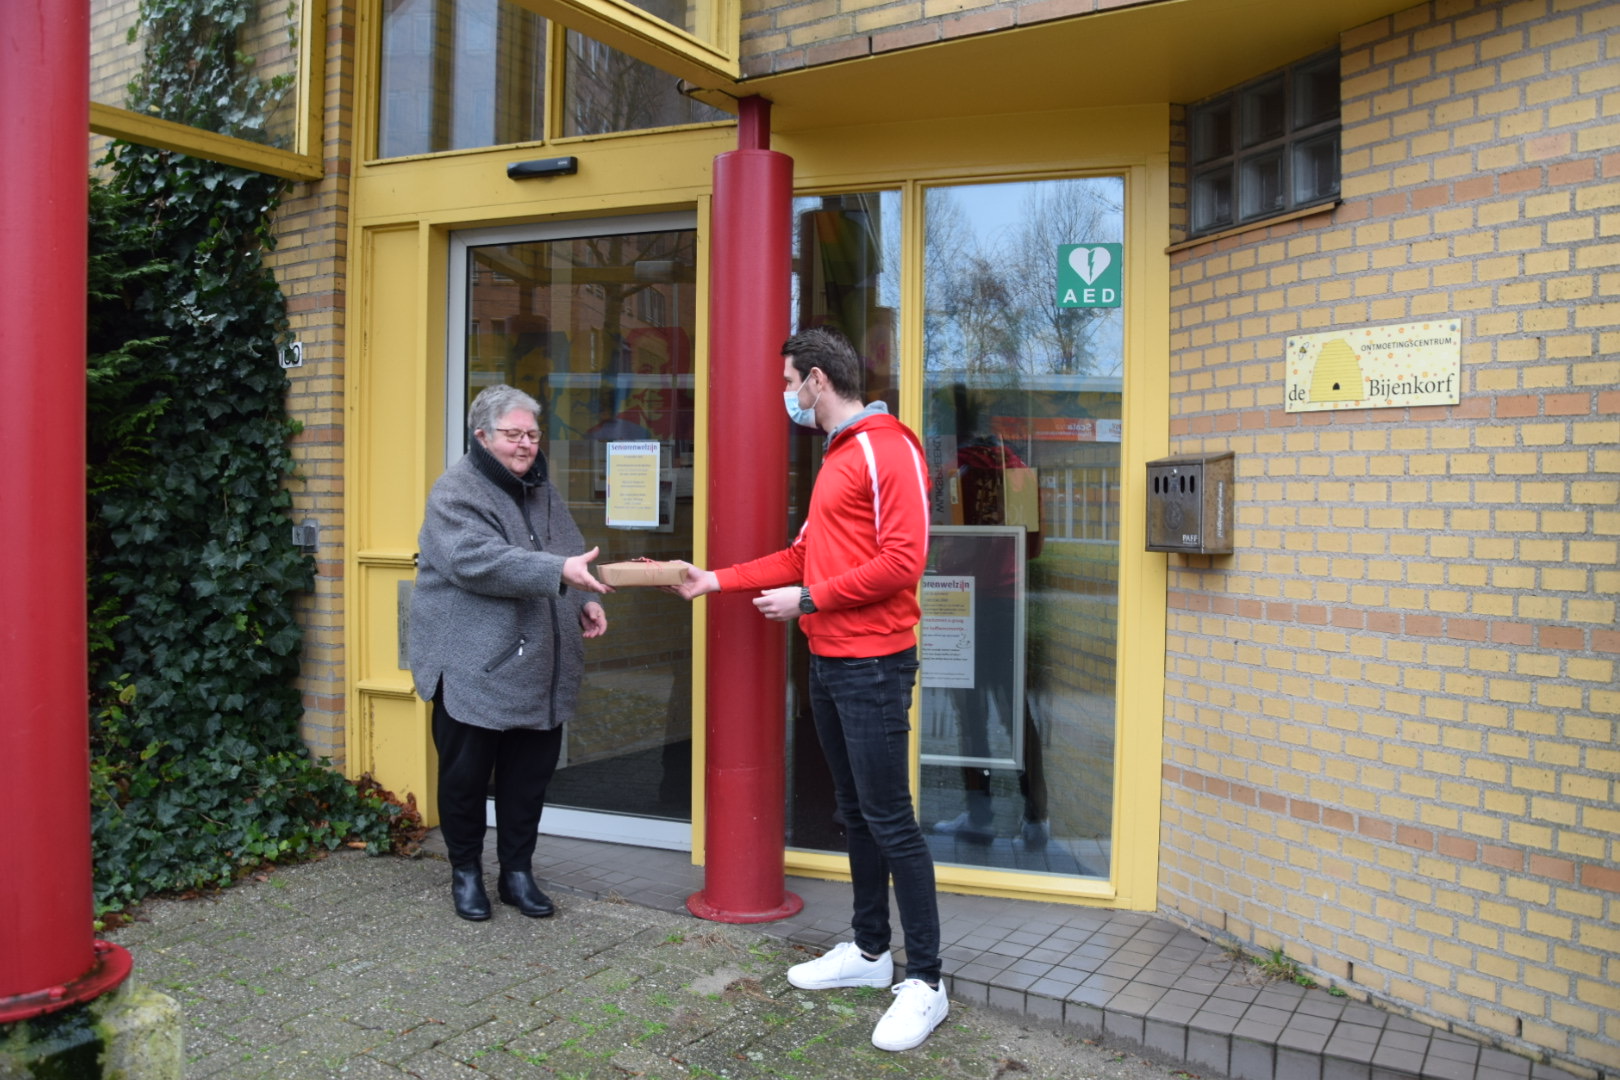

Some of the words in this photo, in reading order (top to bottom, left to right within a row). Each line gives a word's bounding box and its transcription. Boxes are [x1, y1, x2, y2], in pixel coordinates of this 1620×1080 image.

[1063, 288, 1115, 303] AED
[1360, 337, 1452, 352] ONTMOETINGSCENTRUM
[1288, 384, 1306, 401] de
[1368, 373, 1455, 402] Bijenkorf
